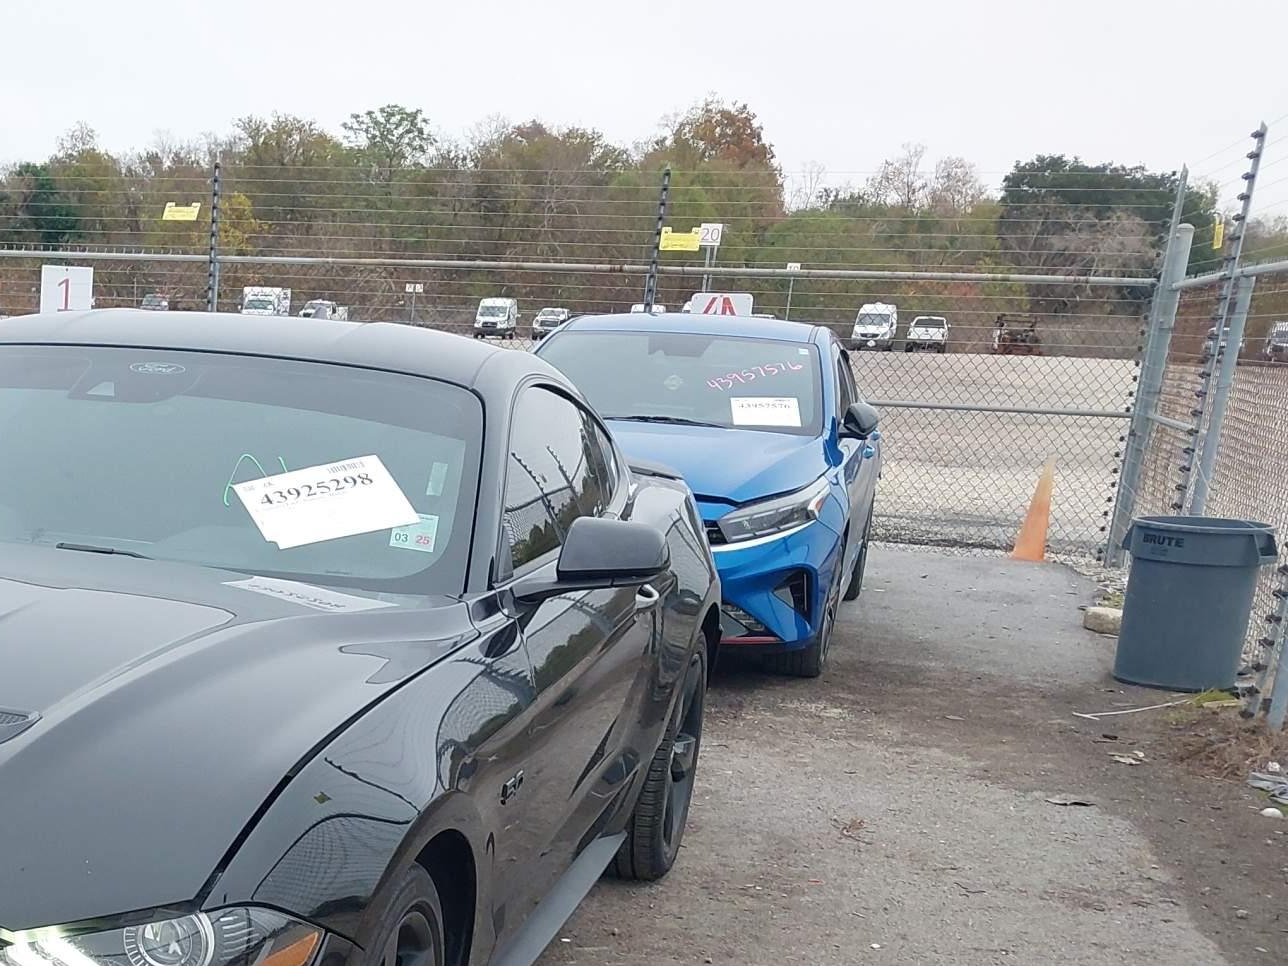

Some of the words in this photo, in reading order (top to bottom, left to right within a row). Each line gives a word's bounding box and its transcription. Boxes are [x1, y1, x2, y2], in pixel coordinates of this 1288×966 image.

[701, 227, 720, 242] 20
[56, 277, 73, 313] 1
[706, 361, 803, 391] 43957576
[260, 473, 373, 504] 43925298
[394, 532, 409, 543] 03
[1143, 534, 1184, 547] BRUTE
